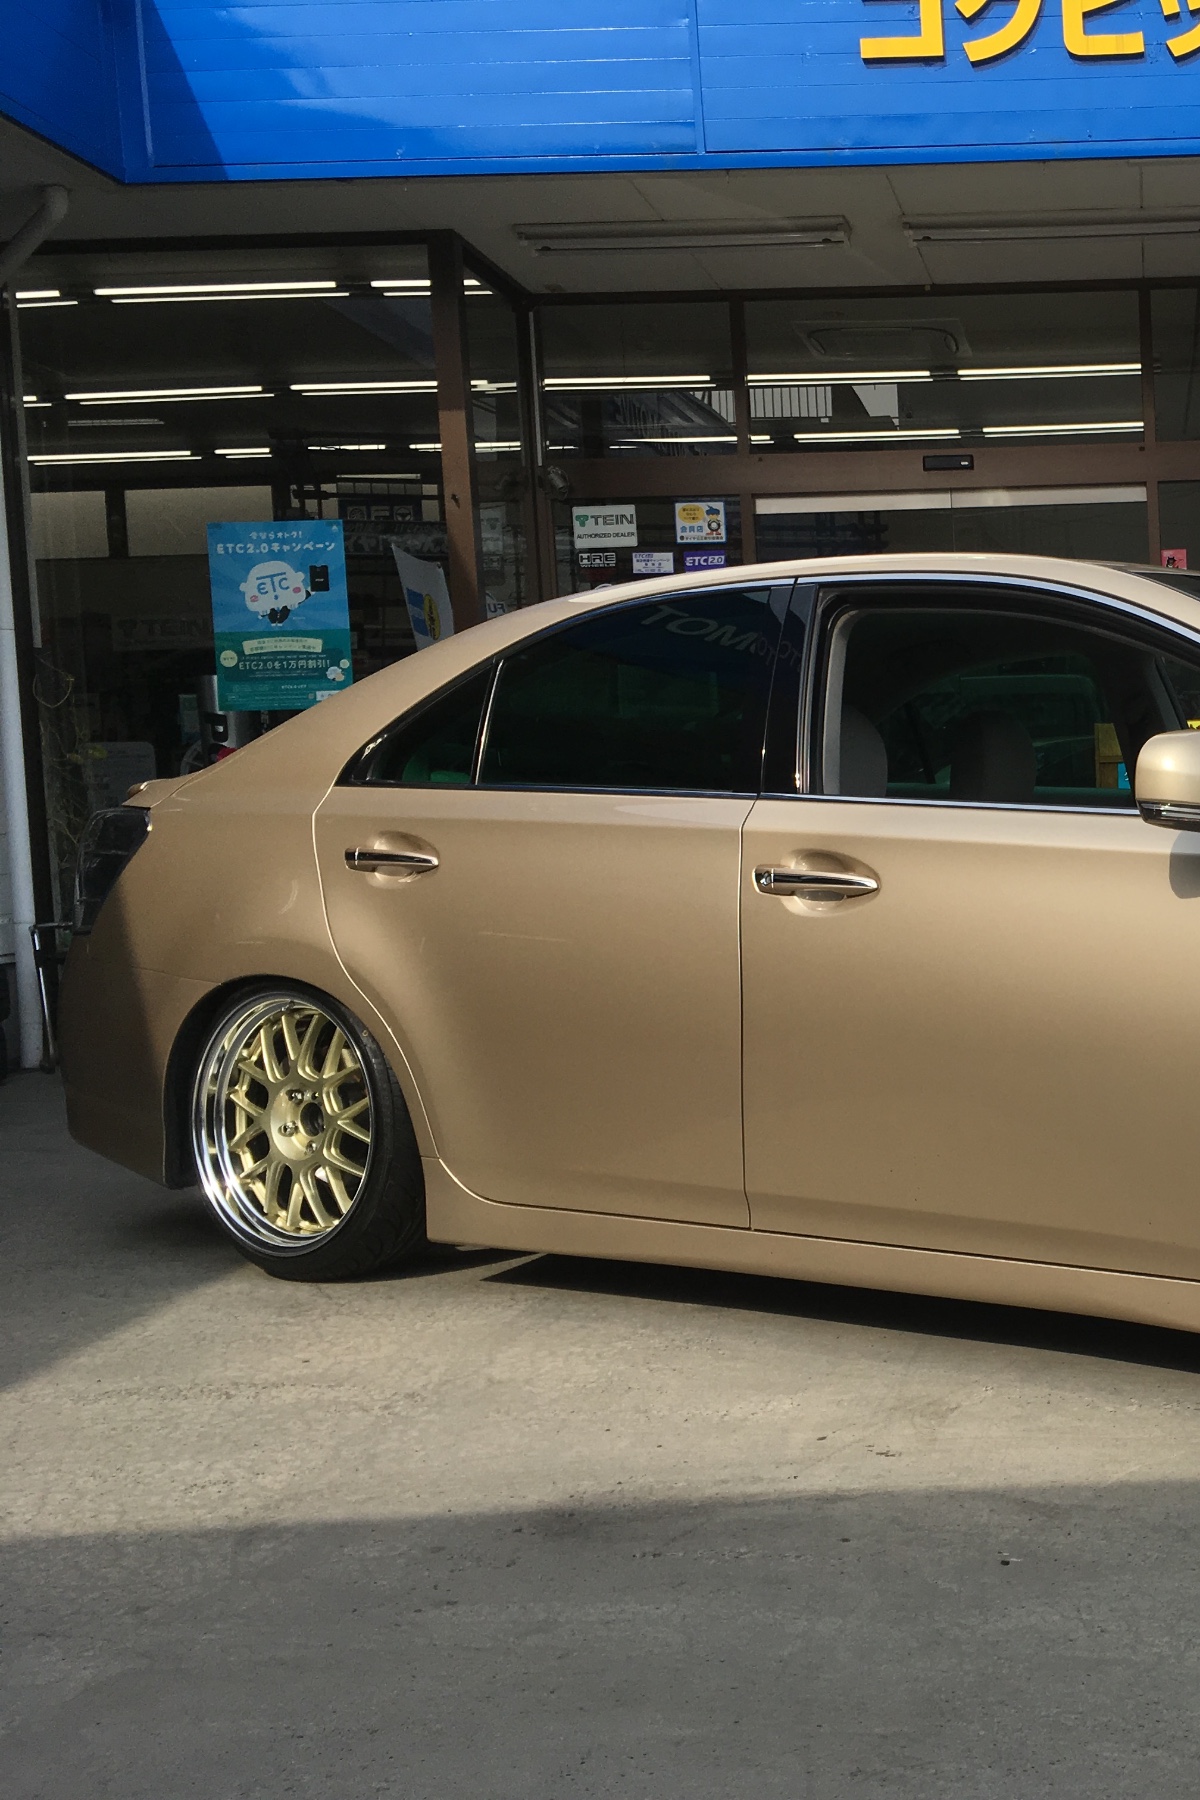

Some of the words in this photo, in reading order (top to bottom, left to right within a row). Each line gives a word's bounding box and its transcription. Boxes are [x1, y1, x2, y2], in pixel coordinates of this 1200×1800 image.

[590, 513, 635, 526] TEIN
[680, 525, 704, 533] 会員店
[576, 532, 612, 540] AUTHORIZED
[579, 552, 616, 564] HRE
